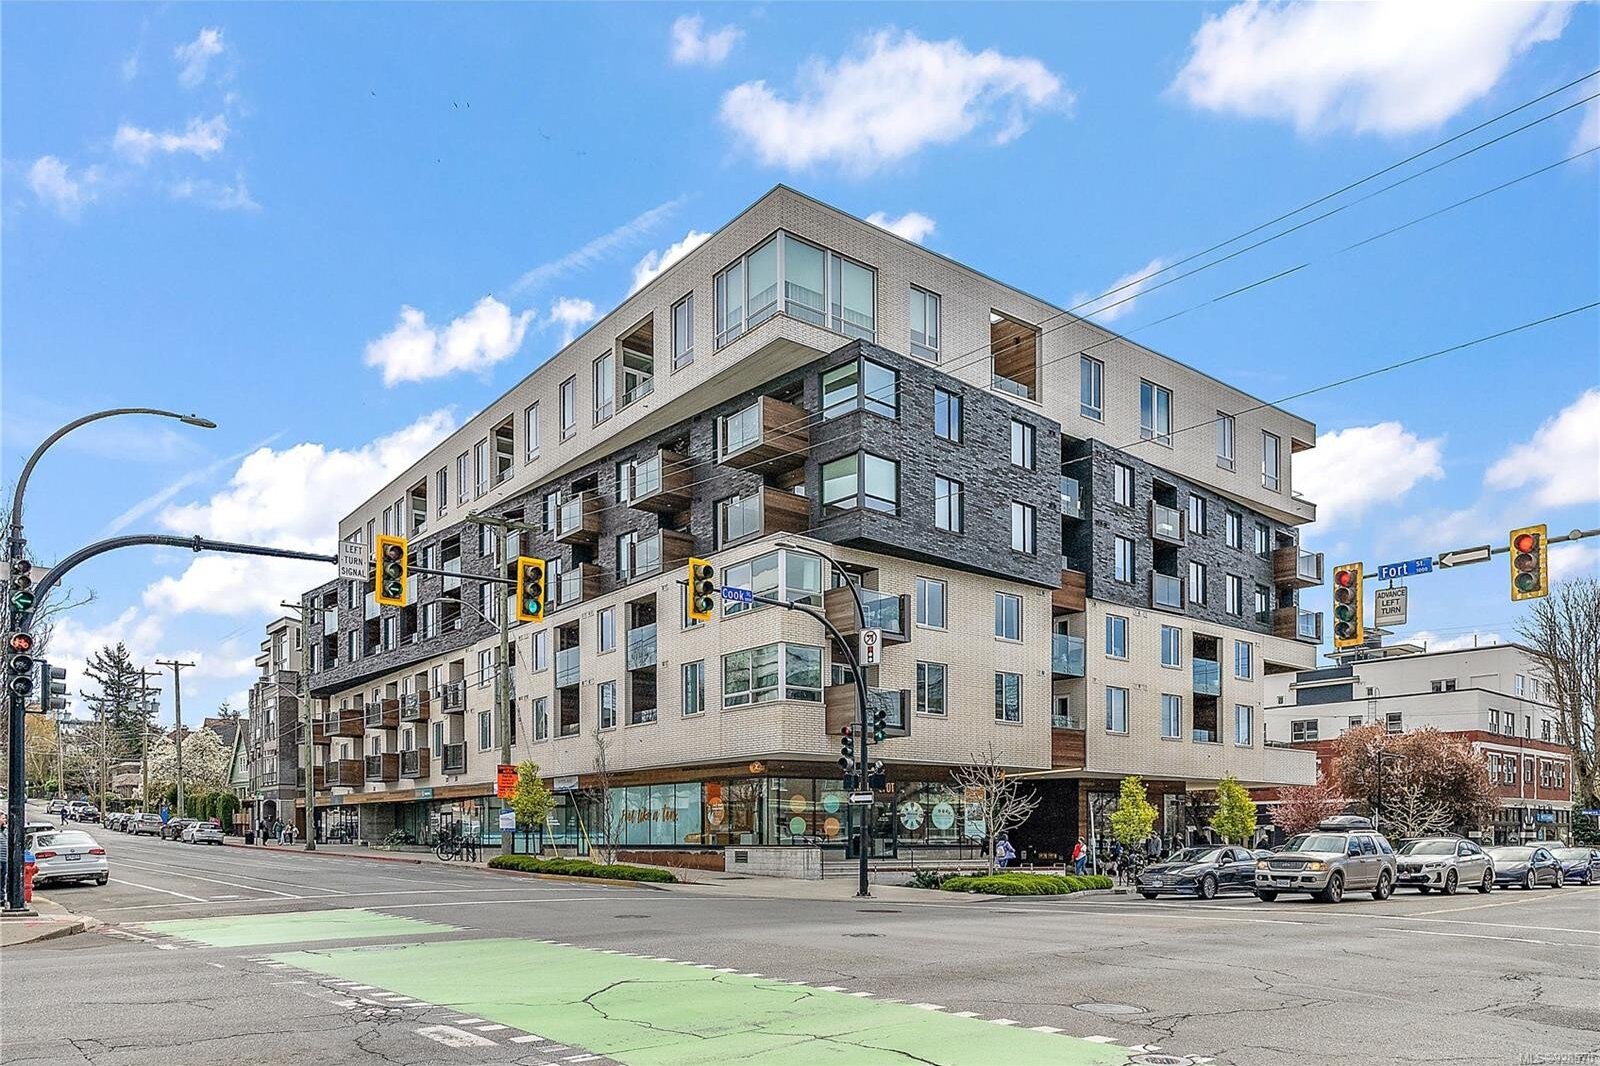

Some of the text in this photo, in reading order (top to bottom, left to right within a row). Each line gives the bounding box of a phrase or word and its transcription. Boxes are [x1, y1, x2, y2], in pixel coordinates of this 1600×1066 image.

[345, 545, 363, 555] LEFT
[344, 556, 363, 566] TURN
[341, 566, 367, 578] SIGNAL
[1382, 563, 1408, 578] Fort
[722, 588, 745, 601] Cook
[1377, 589, 1406, 599] ADVANCE
[1381, 598, 1400, 607] LEFT
[1381, 606, 1401, 615] TURN
